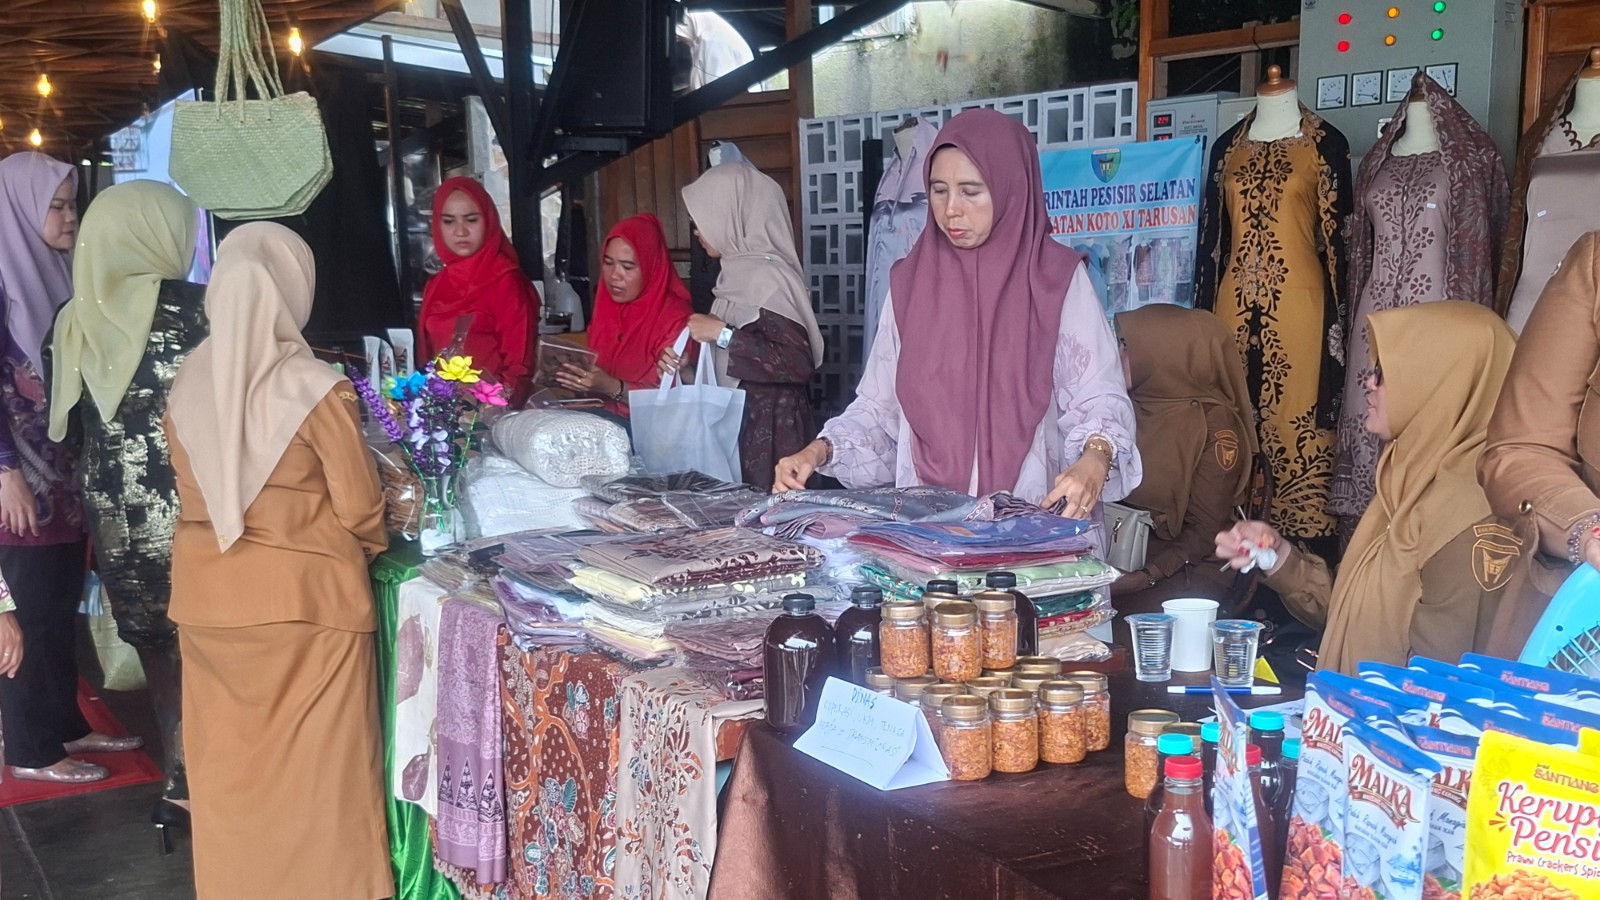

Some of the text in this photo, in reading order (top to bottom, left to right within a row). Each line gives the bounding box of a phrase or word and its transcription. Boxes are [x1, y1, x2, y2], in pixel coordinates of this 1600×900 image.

[1091, 184, 1137, 206] PESISIR
[1140, 178, 1196, 202] SELATAN
[1087, 211, 1119, 232] KOTO
[1122, 210, 1136, 230] XI
[1138, 205, 1197, 227] TARUSAN
[1349, 754, 1421, 824] MALKA
[1534, 768, 1600, 794] SANTIANG
[1498, 782, 1600, 836] Kerup
[1507, 851, 1535, 865] Prawn
[1538, 857, 1579, 876] Crackers
